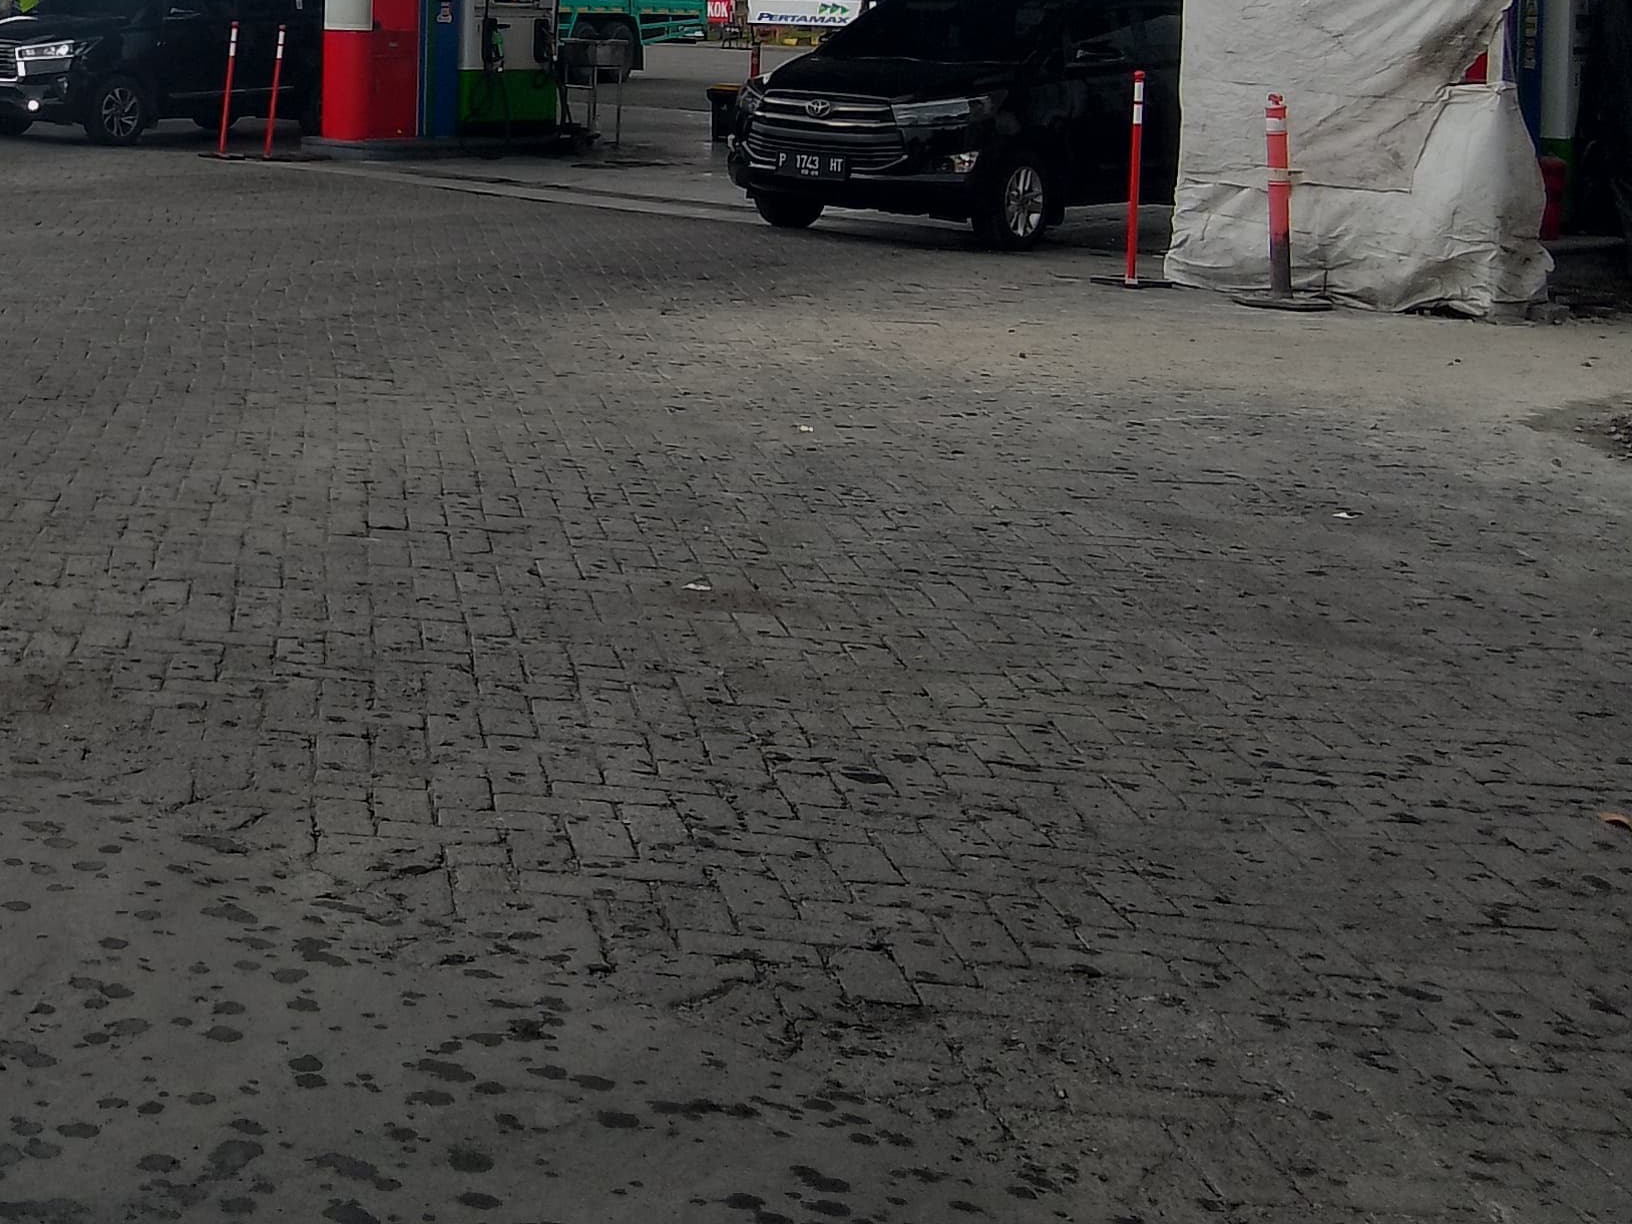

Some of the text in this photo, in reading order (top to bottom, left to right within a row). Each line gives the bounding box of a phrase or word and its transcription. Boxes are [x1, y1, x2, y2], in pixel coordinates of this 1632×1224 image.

[757, 12, 849, 25] PERTAMAX
[779, 152, 843, 172] P 1743 HT
